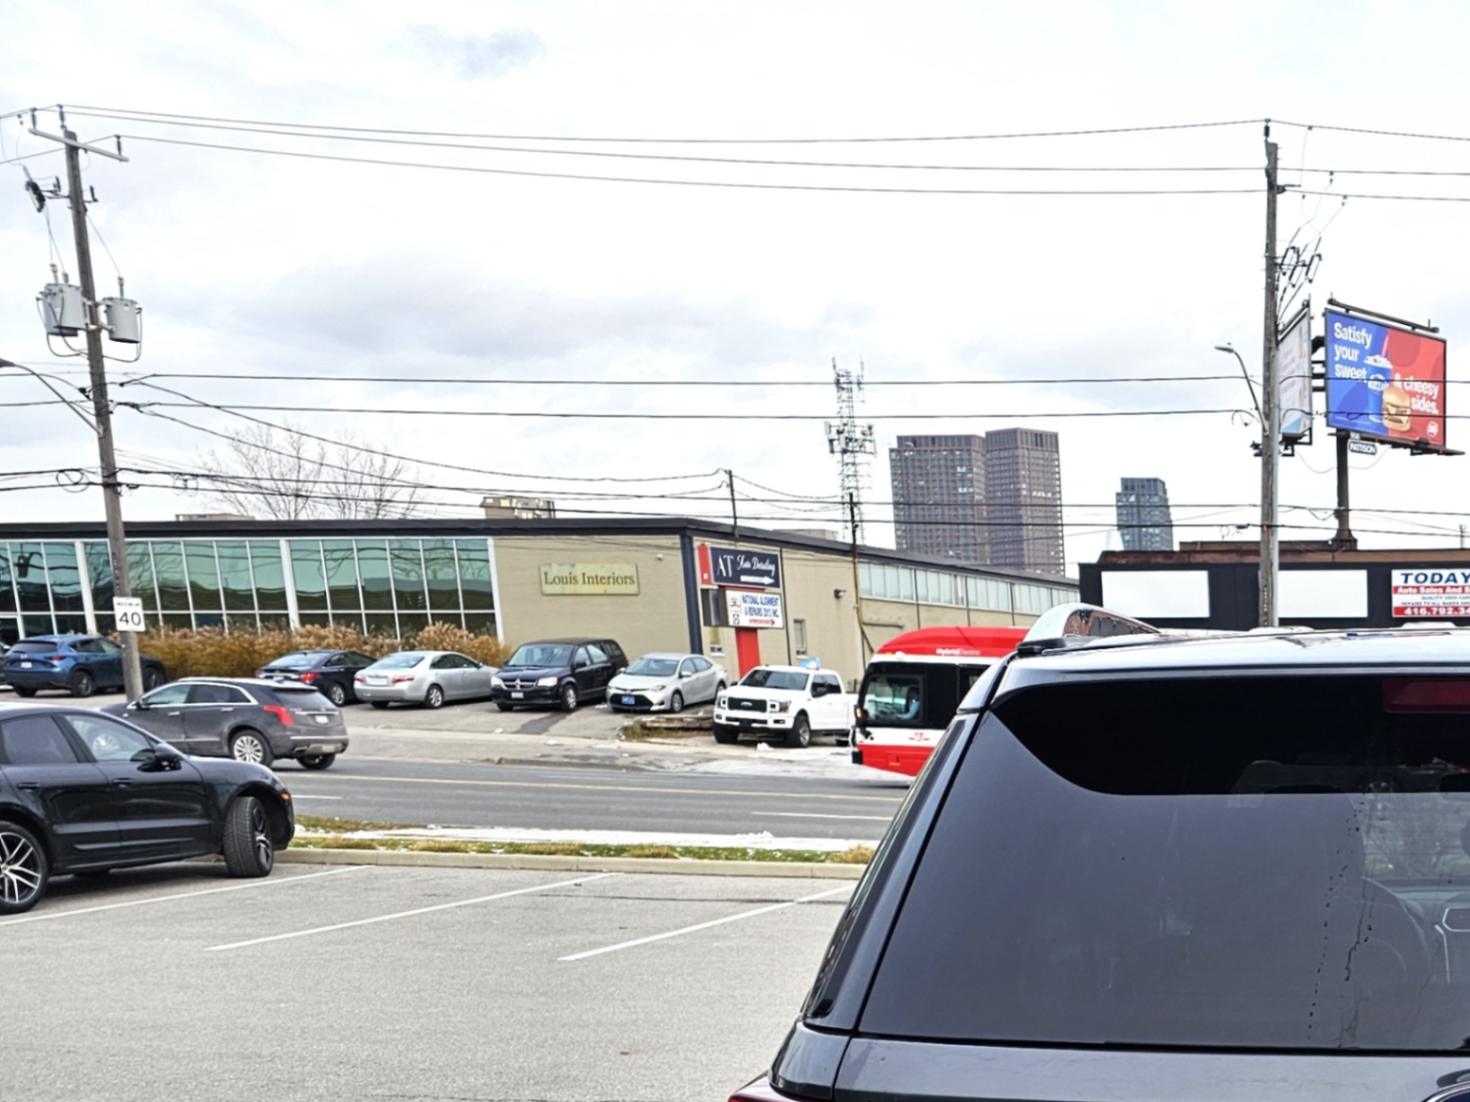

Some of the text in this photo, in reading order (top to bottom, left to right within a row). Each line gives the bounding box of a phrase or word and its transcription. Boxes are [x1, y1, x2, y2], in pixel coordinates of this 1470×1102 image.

[1334, 322, 1372, 349] Satisfy
[1334, 344, 1359, 362] your
[1403, 375, 1439, 400] cheesy
[716, 554, 734, 577] AT
[544, 572, 635, 585] Louis Interiors
[1398, 586, 1418, 594] Auto
[1419, 586, 1443, 594] Sales
[1445, 586, 1462, 594] And
[119, 611, 141, 626] 40
